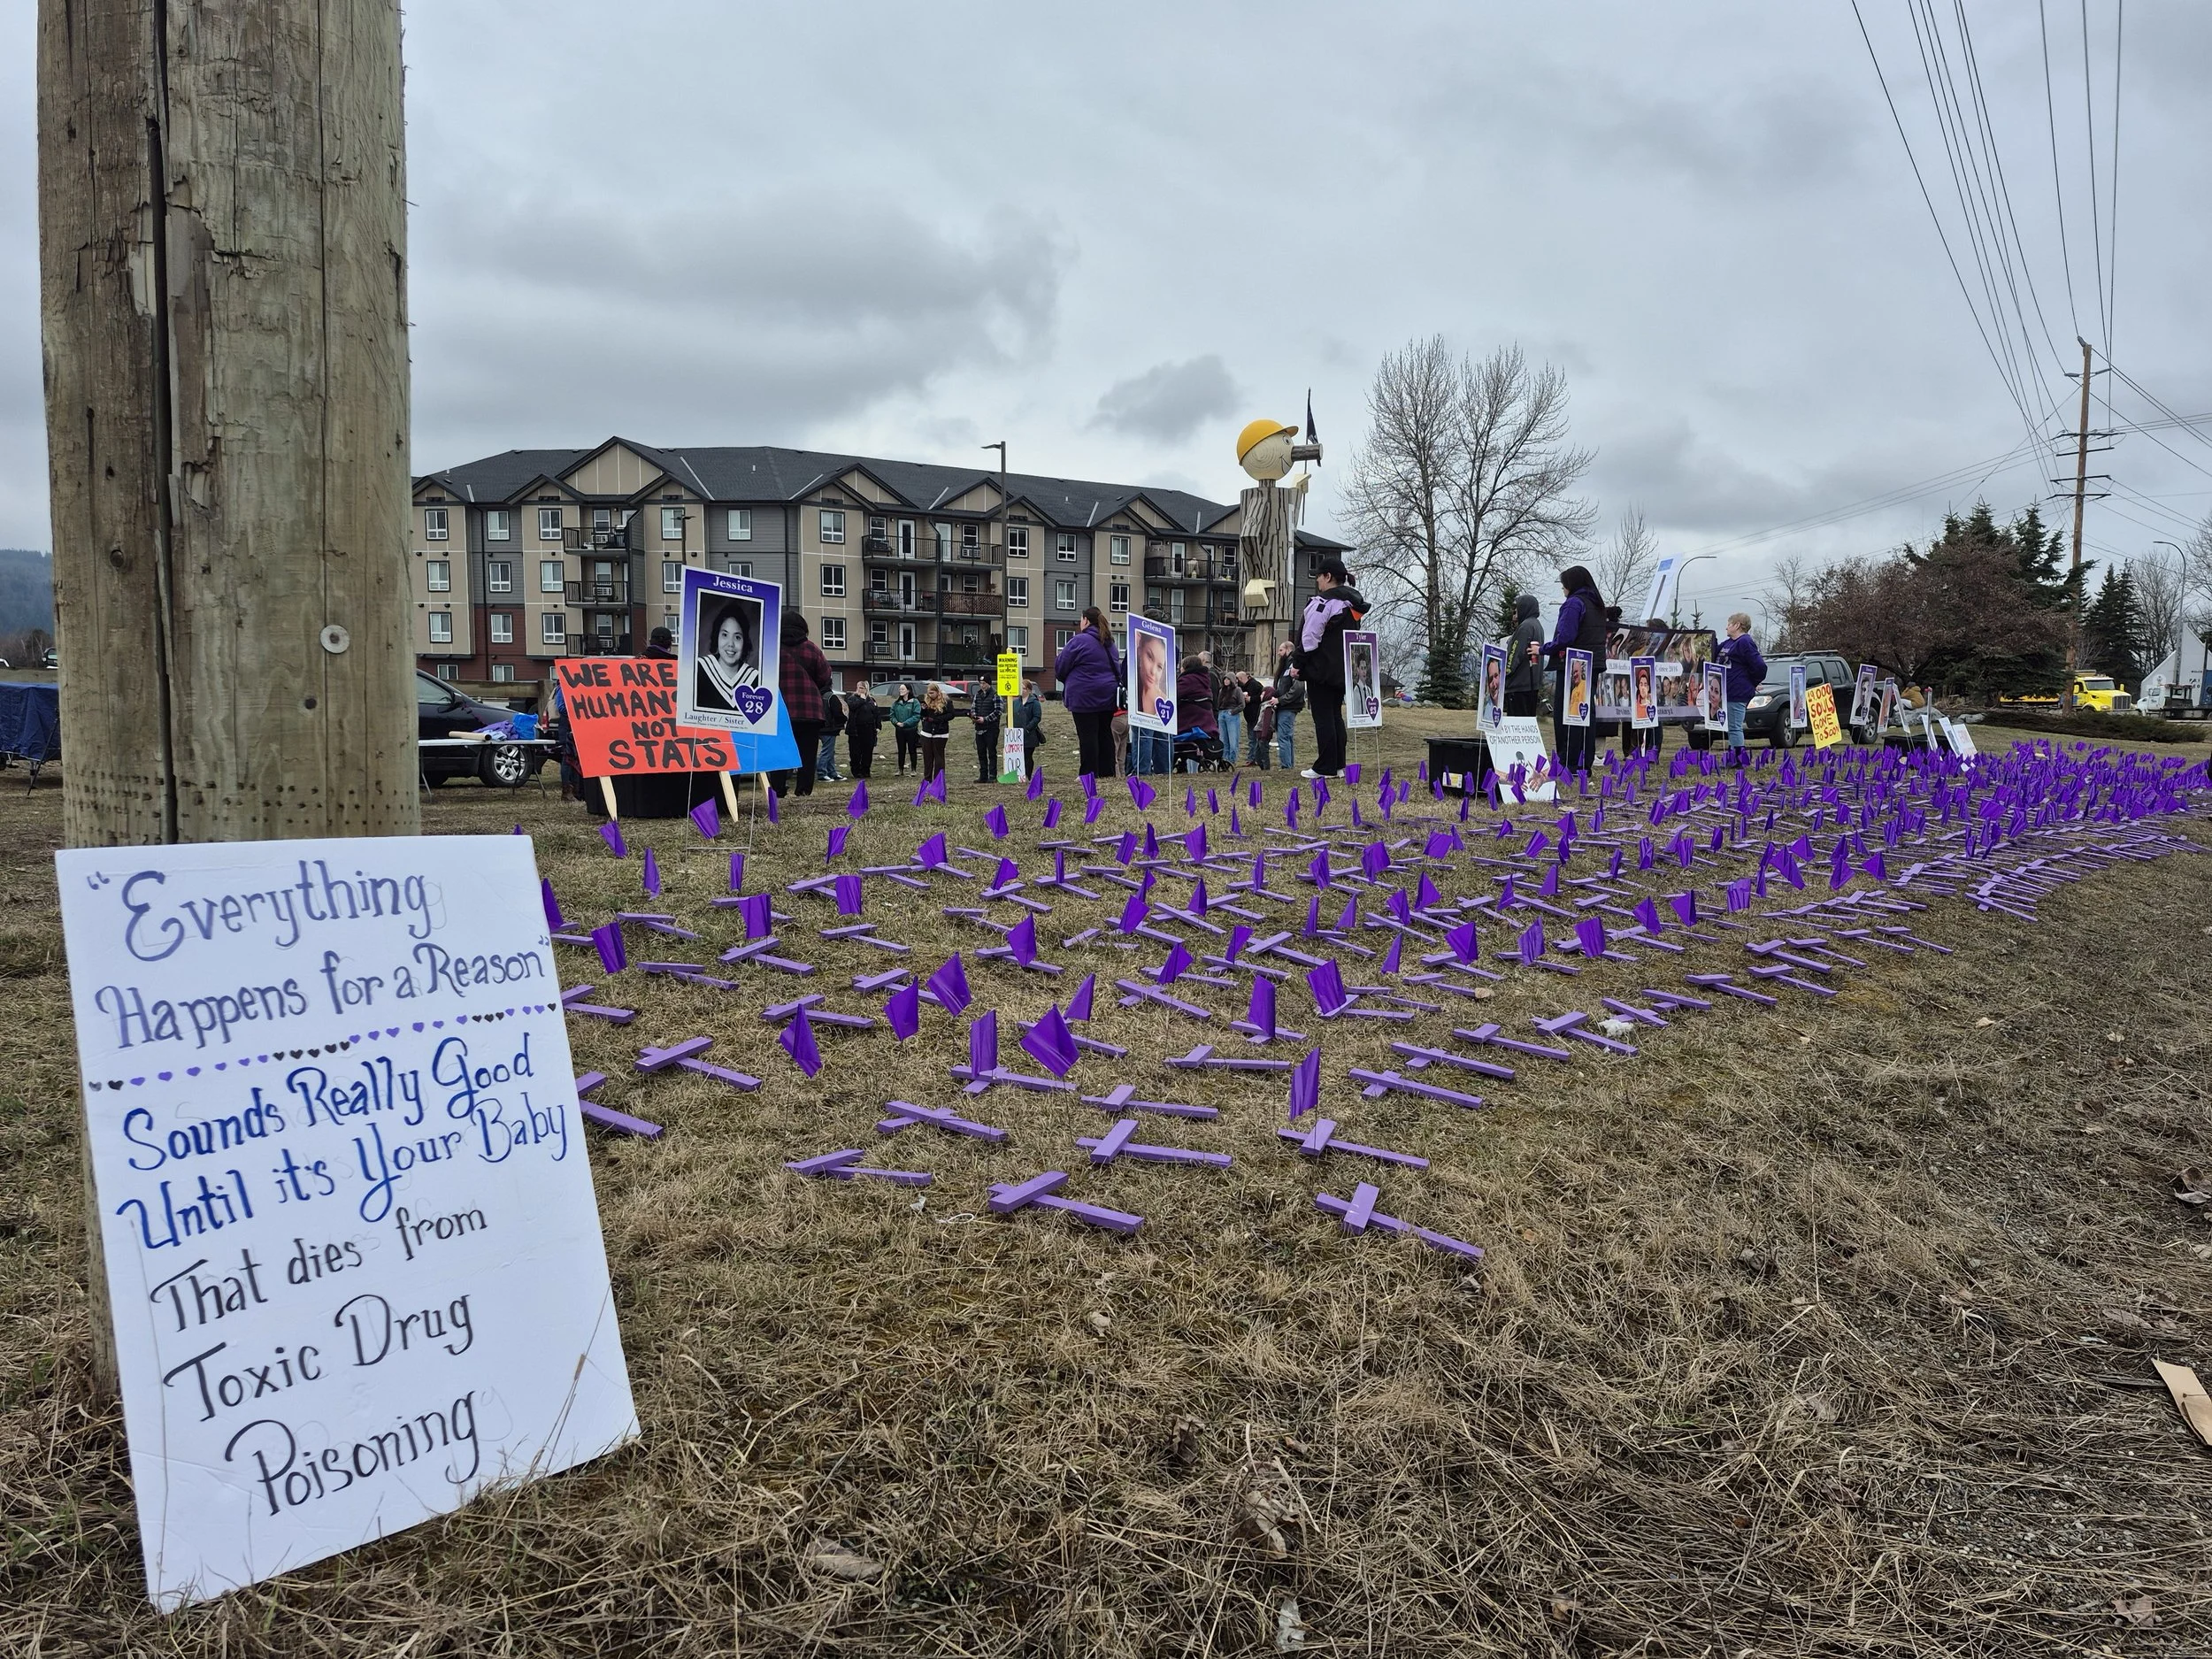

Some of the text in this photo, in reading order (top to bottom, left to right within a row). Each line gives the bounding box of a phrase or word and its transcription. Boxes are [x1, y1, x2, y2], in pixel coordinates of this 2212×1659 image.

[712, 575, 754, 594] Jessica
[560, 663, 678, 688] WE ARE
[741, 691, 765, 702] Forever
[745, 702, 764, 716] 28
[1160, 709, 1171, 719] 21
[1810, 695, 1836, 718] SOULS
[684, 711, 718, 723] Laughter
[725, 716, 745, 726] Sister
[1813, 713, 1834, 730] GONE
[631, 718, 679, 740] NOT
[1005, 728, 1022, 743] YOUR
[1505, 725, 1511, 733] BY
[1511, 725, 1521, 733] THE
[1522, 725, 1539, 733] HANDS
[1005, 743, 1024, 753] COMFORT
[1489, 735, 1541, 745] OF ANOTHER PERSON
[609, 737, 728, 770] STATS
[1008, 757, 1022, 772] OUR
[95, 978, 306, 1050] Happens
[319, 949, 385, 1015] for
[395, 969, 419, 1001] a
[122, 1032, 534, 1171] Sounds Really Good
[116, 1092, 568, 1250] Until it's Your Baby
[150, 1204, 489, 1333] That dies from
[162, 1293, 475, 1422] Toxic Drug
[224, 1389, 480, 1517] Poisoning
